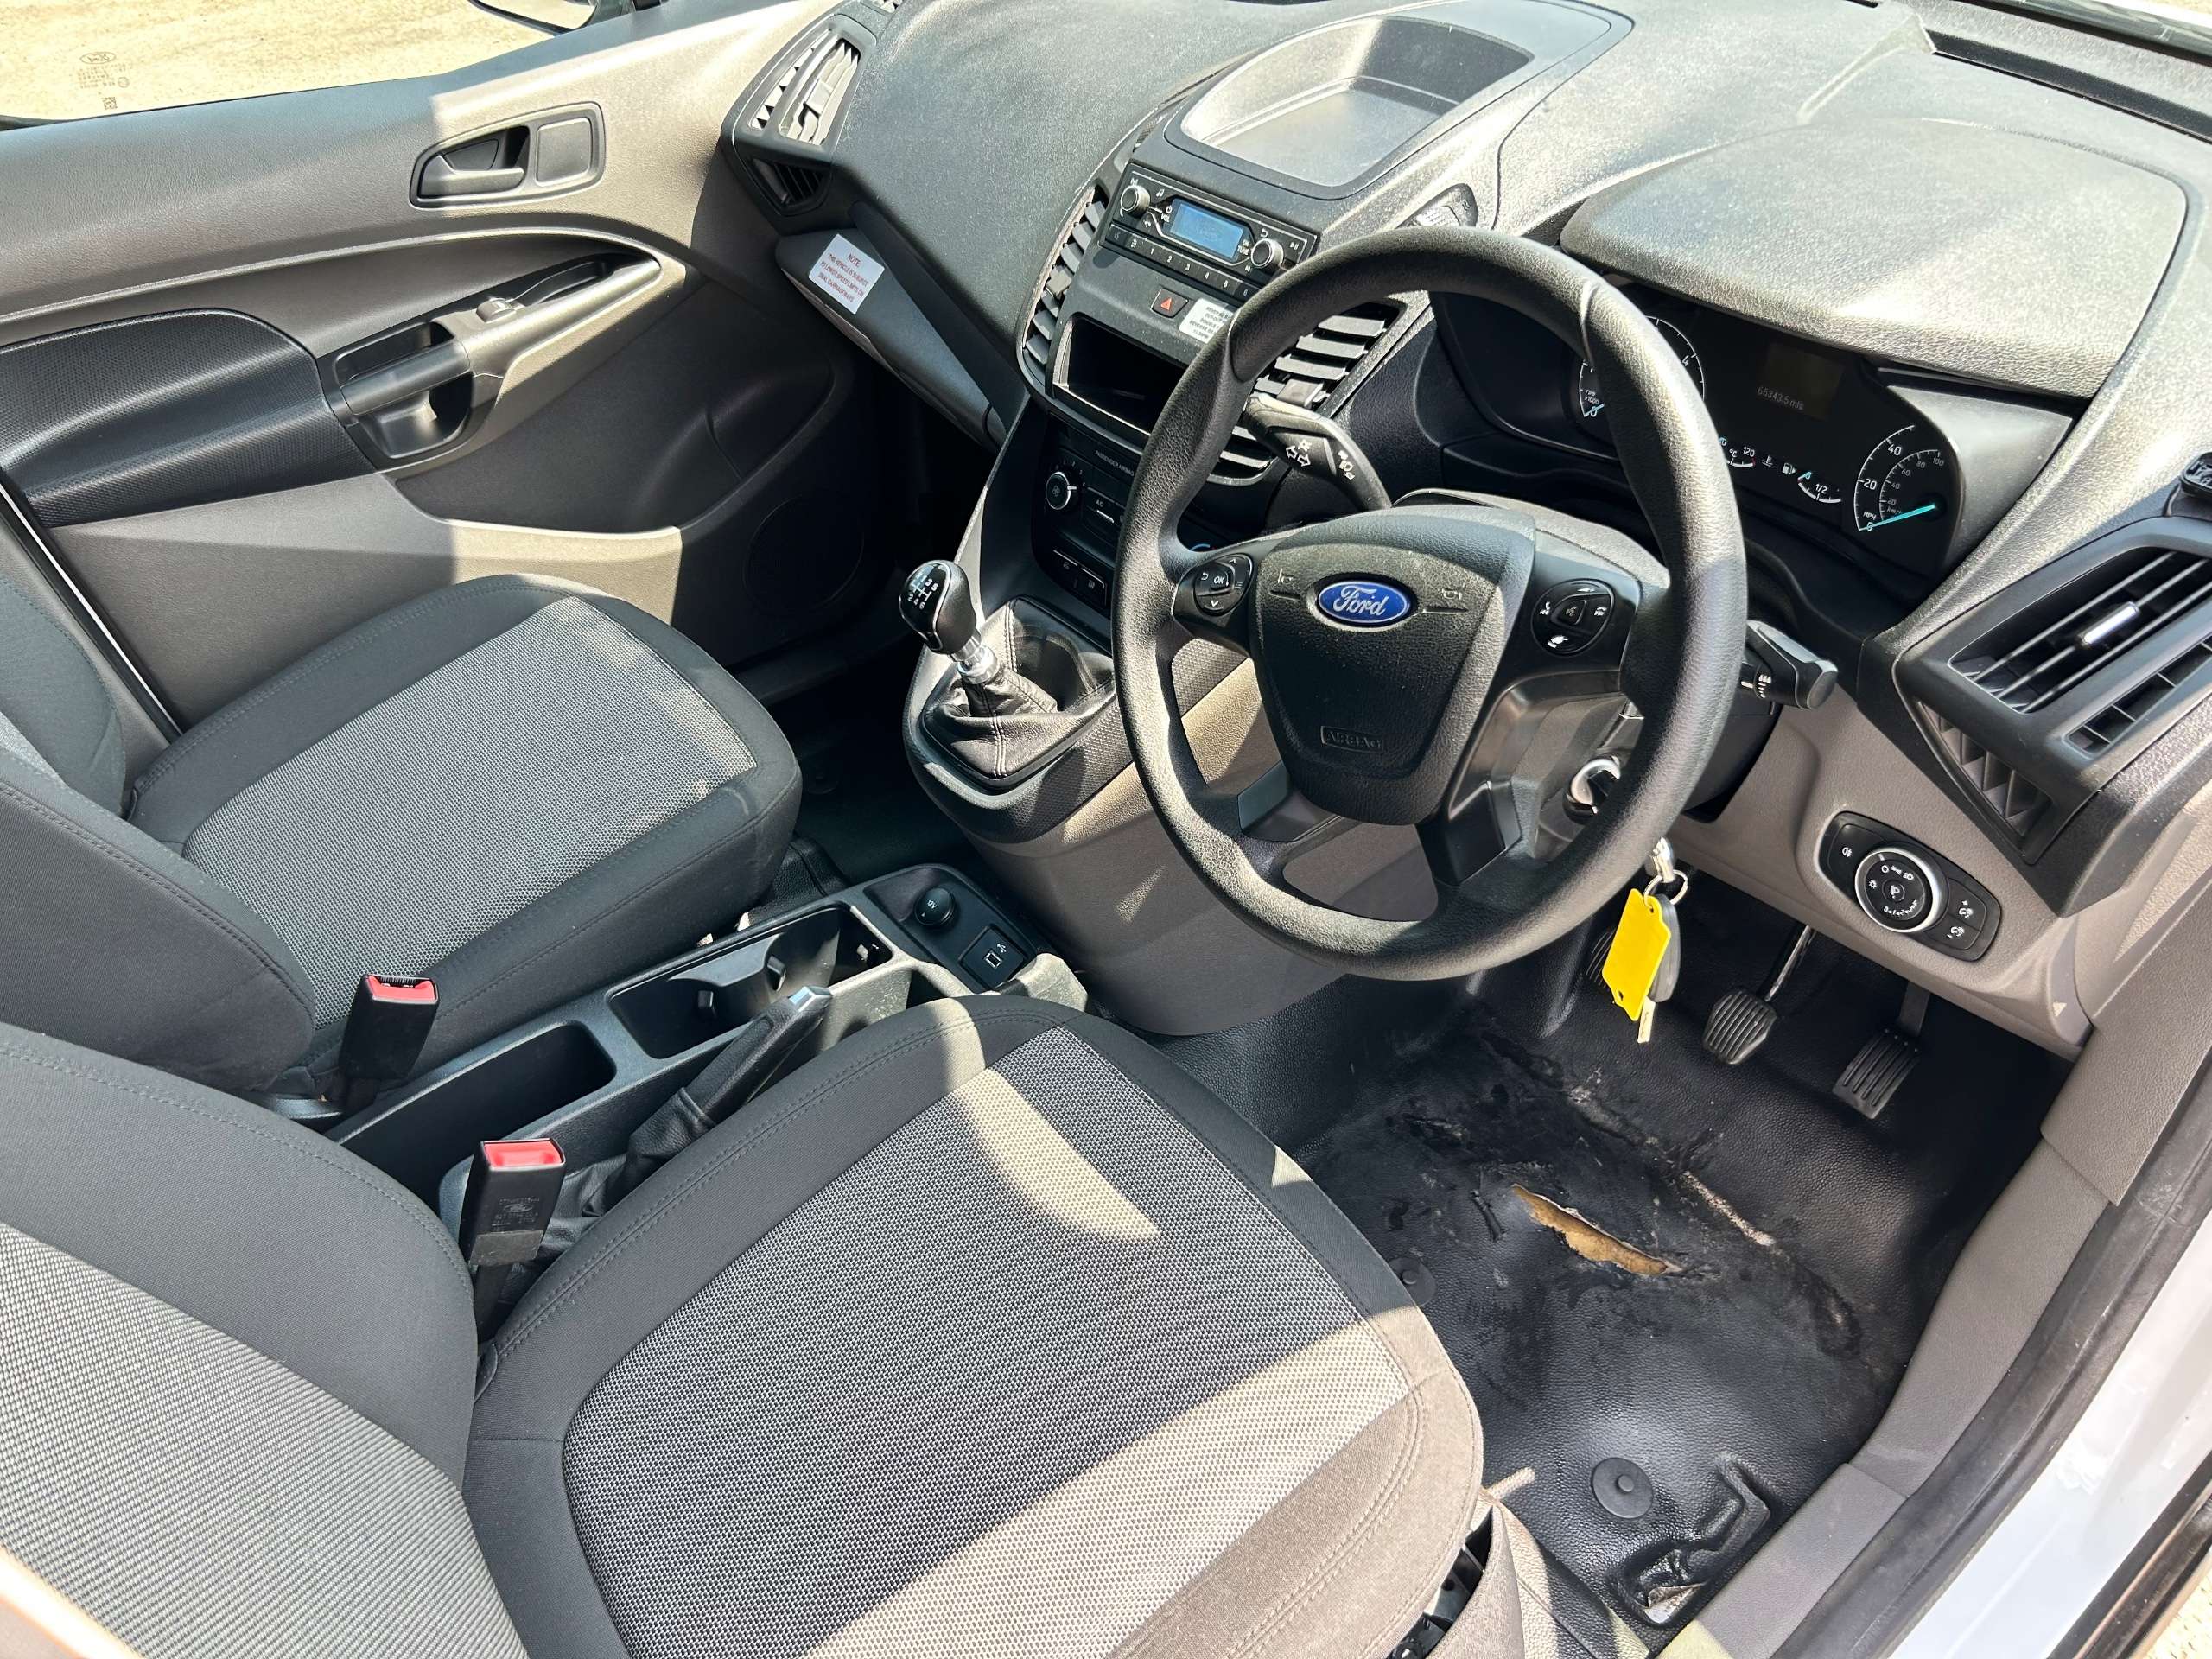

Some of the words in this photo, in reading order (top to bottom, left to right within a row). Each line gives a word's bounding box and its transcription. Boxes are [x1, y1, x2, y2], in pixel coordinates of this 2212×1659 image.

[1743, 447, 1755, 457] 120
[1888, 444, 1902, 455] 40
[1932, 458, 1944, 467] 100
[1815, 484, 1828, 493] 1/2
[1864, 479, 1877, 490] 20
[1863, 512, 1876, 520] MPH
[1213, 575, 1225, 584] OK
[1332, 585, 1389, 616] Ford
[1326, 731, 1382, 750] AIRBAG
